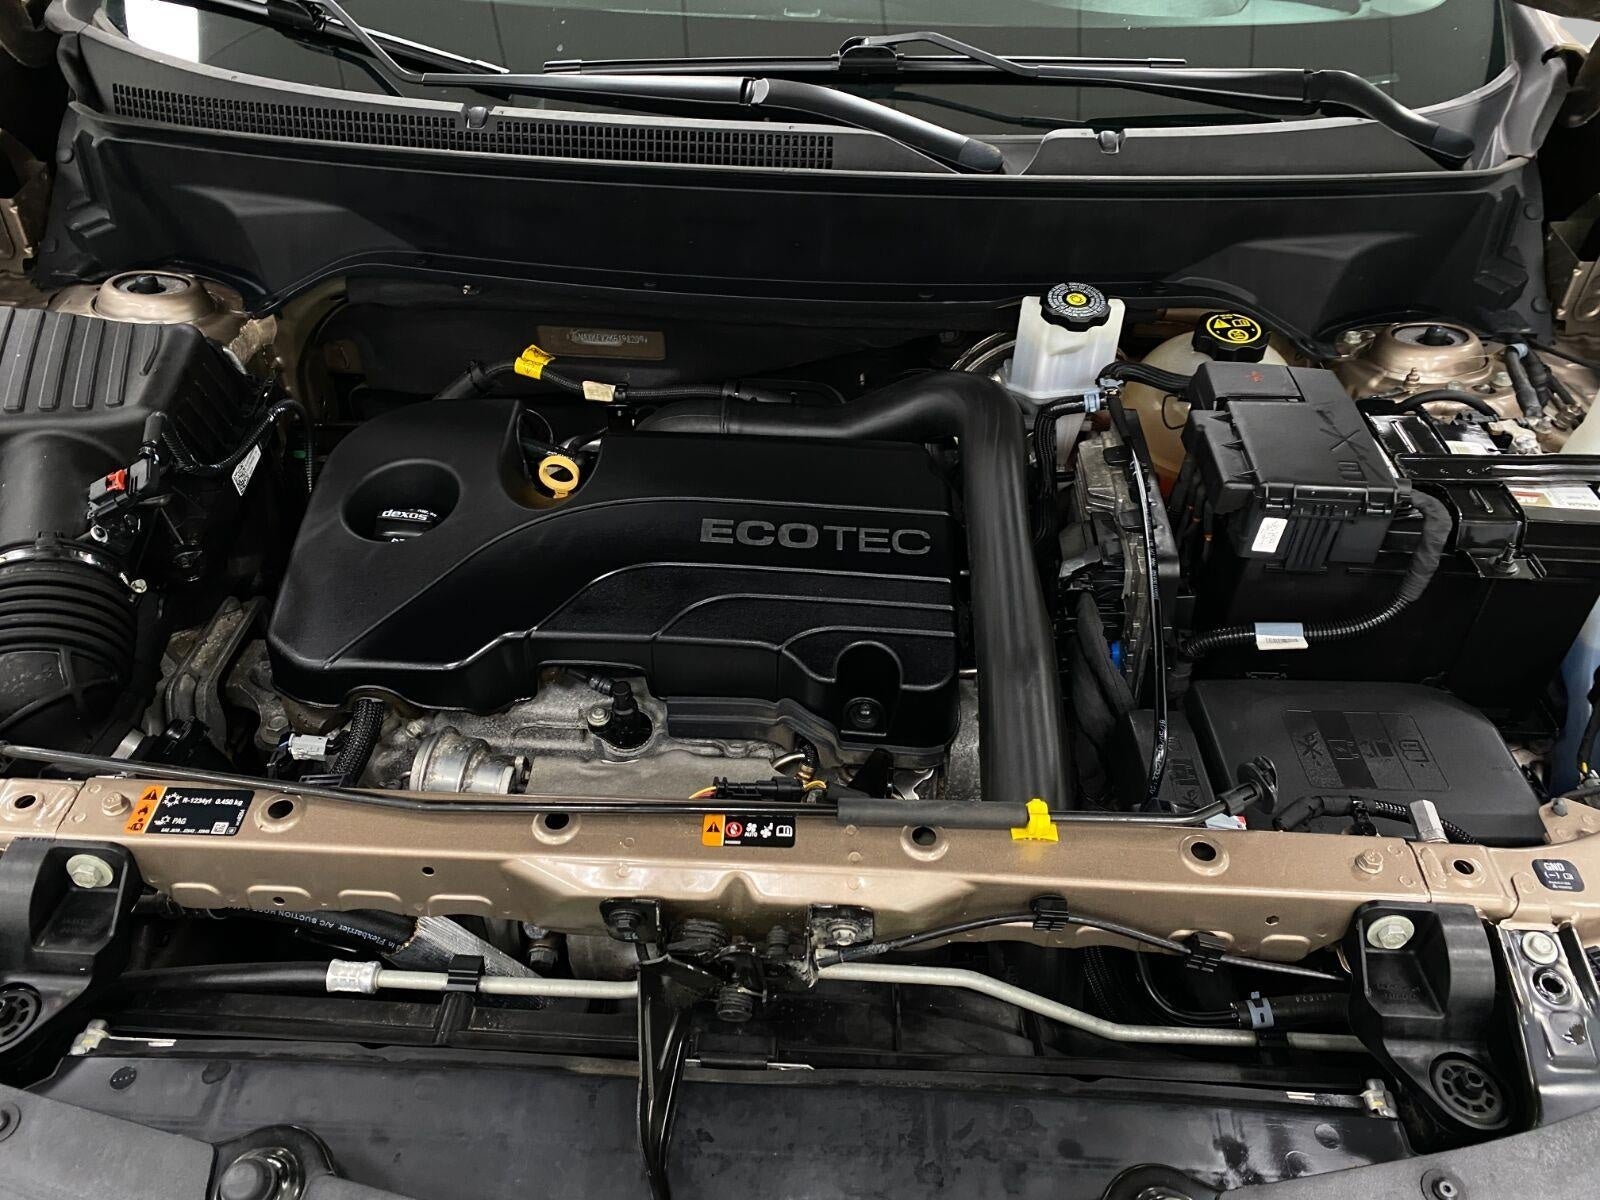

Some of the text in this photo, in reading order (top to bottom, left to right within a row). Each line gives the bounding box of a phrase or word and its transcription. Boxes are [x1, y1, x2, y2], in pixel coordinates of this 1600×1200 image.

[381, 508, 429, 521] dexos
[699, 517, 932, 555] ECOTEC
[233, 798, 244, 807] kg
[171, 817, 187, 825] PAG
[1543, 862, 1566, 872] GND
[278, 910, 318, 925] SUCTION
[319, 918, 335, 929] A/C
[338, 924, 387, 946] Flexbarrier
